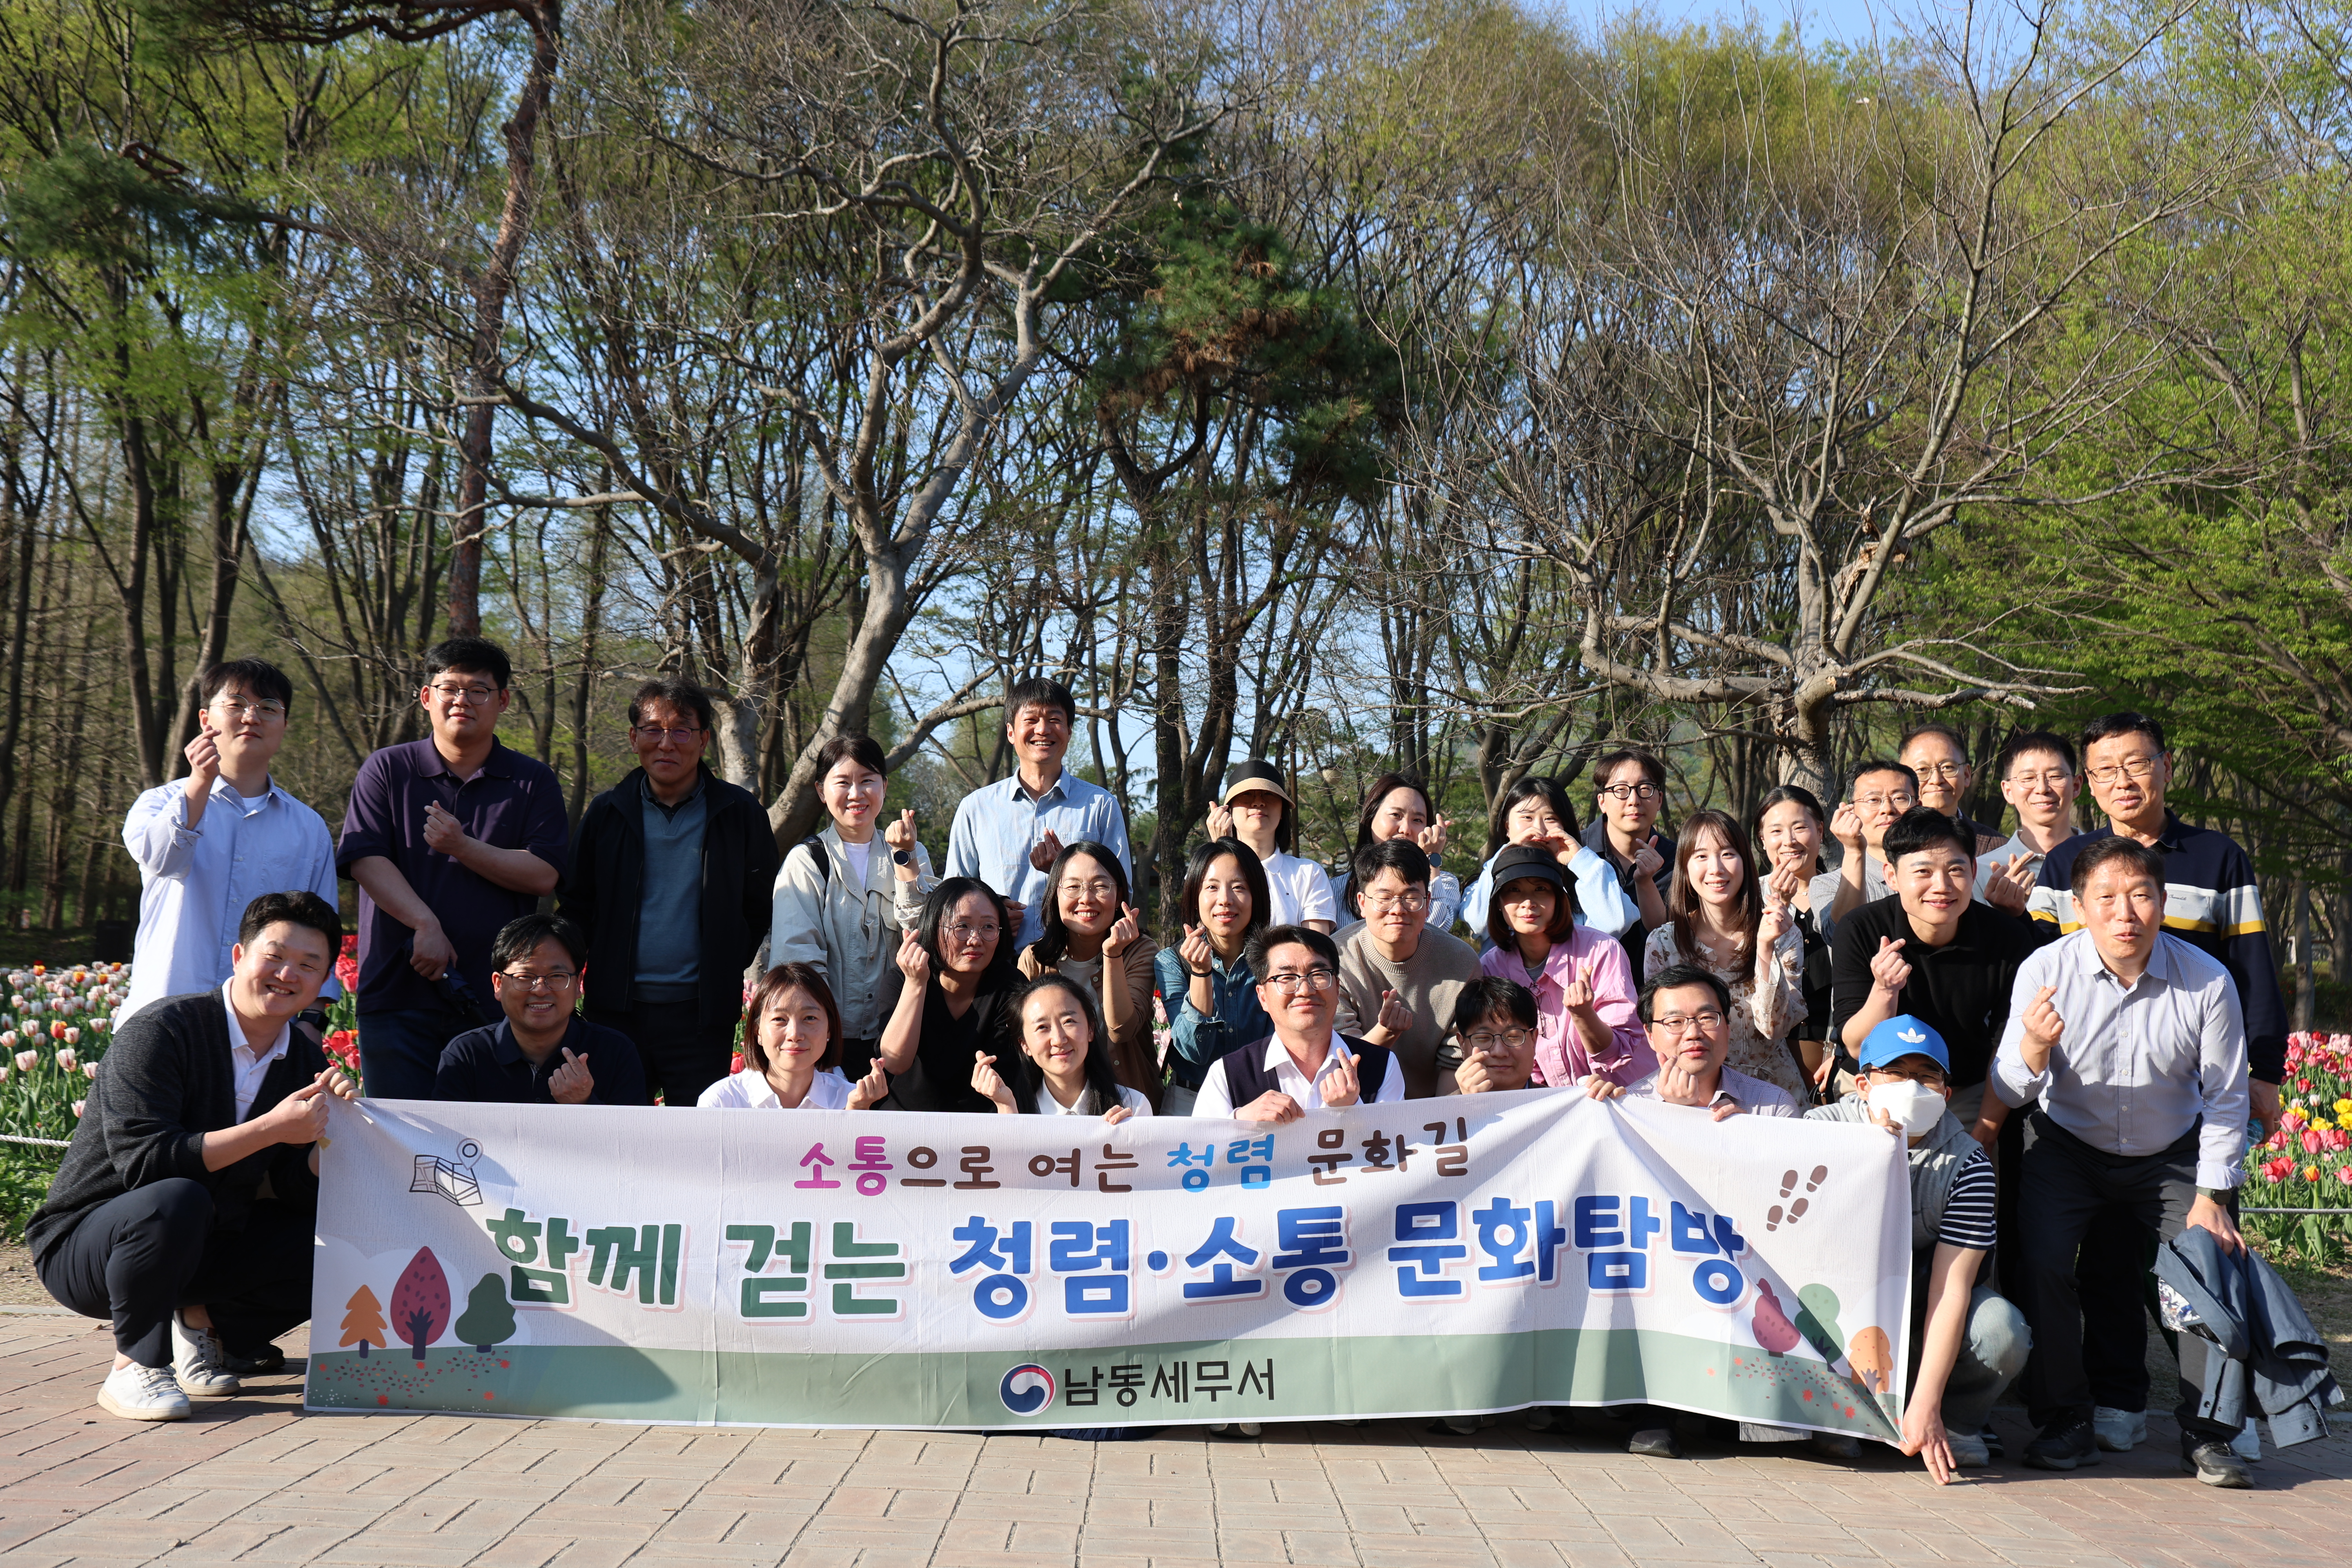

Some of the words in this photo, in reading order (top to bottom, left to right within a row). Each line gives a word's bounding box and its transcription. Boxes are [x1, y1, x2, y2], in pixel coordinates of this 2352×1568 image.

[794, 1136, 1001, 1196] 소통으로
[1028, 1143, 1139, 1193] 여는
[1167, 1134, 1275, 1193] 청렴
[1307, 1117, 1468, 1186] 문화길
[485, 1208, 681, 1305] 함께
[726, 1222, 905, 1317] 걷는
[1388, 1196, 1744, 1304] 문화탐방
[1064, 1358, 1275, 1407] 남동세무서
